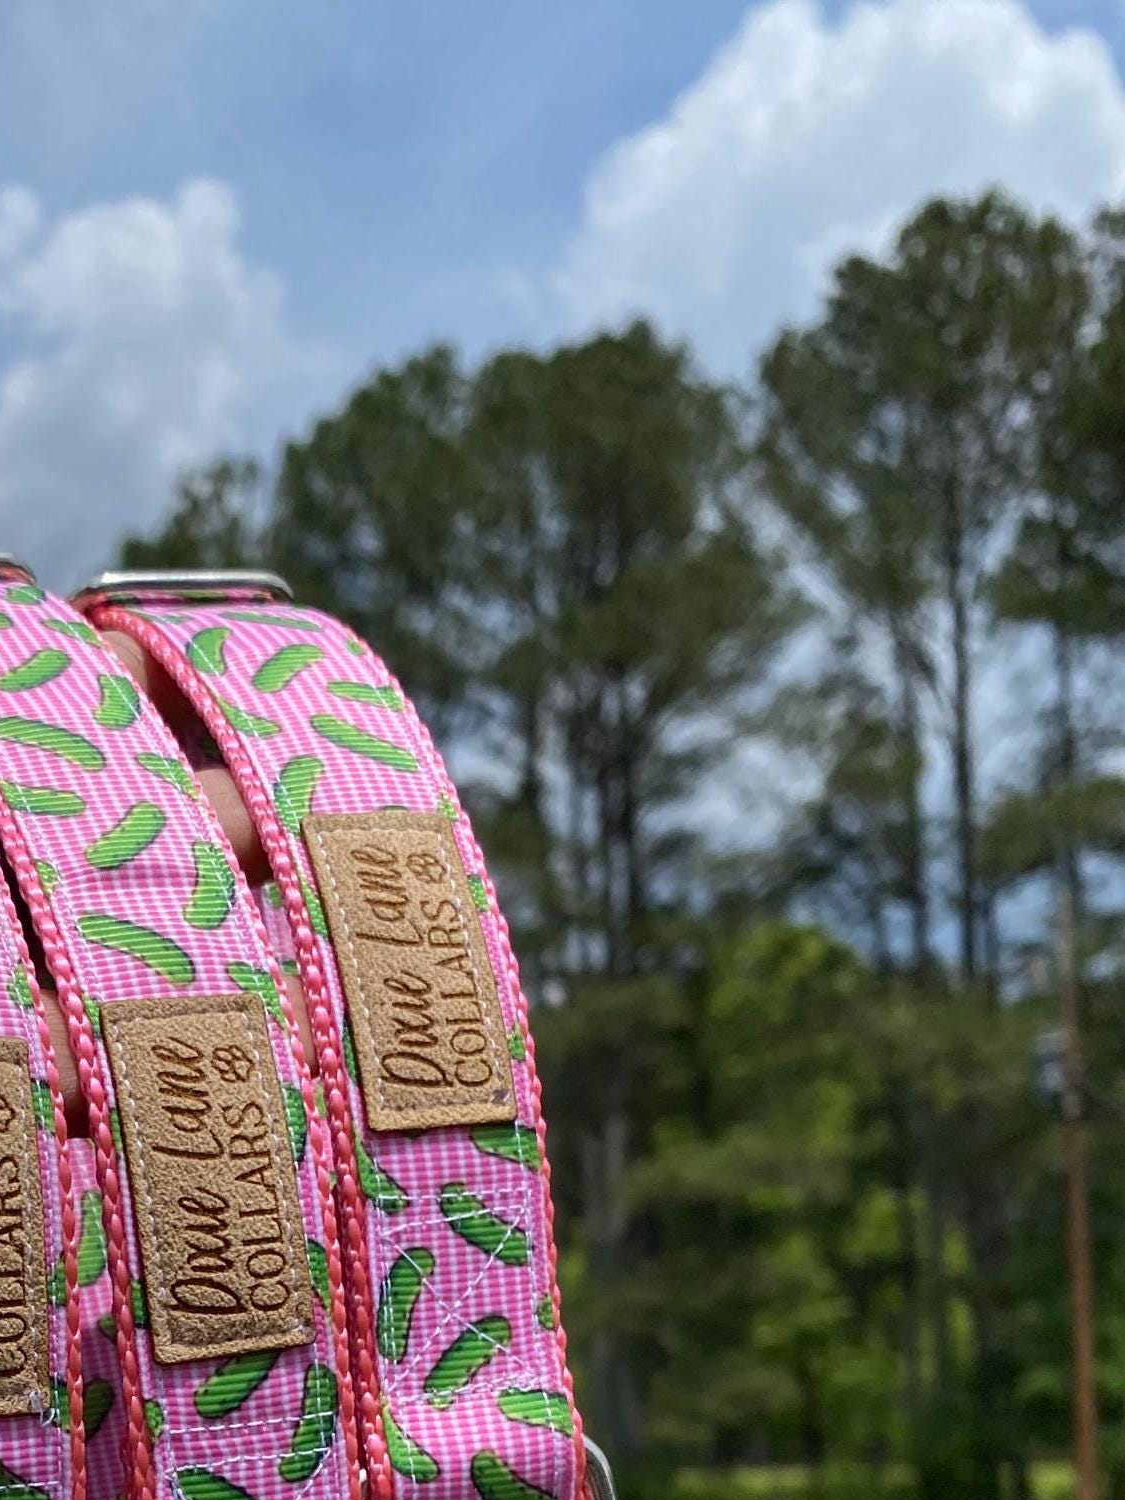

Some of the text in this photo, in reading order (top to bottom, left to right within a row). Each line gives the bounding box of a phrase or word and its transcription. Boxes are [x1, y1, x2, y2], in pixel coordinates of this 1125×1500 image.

[350, 846, 423, 947] Lane
[420, 899, 493, 1087] COLLARS
[151, 1037, 223, 1160] Lane
[222, 1101, 291, 1311] COLLARS
